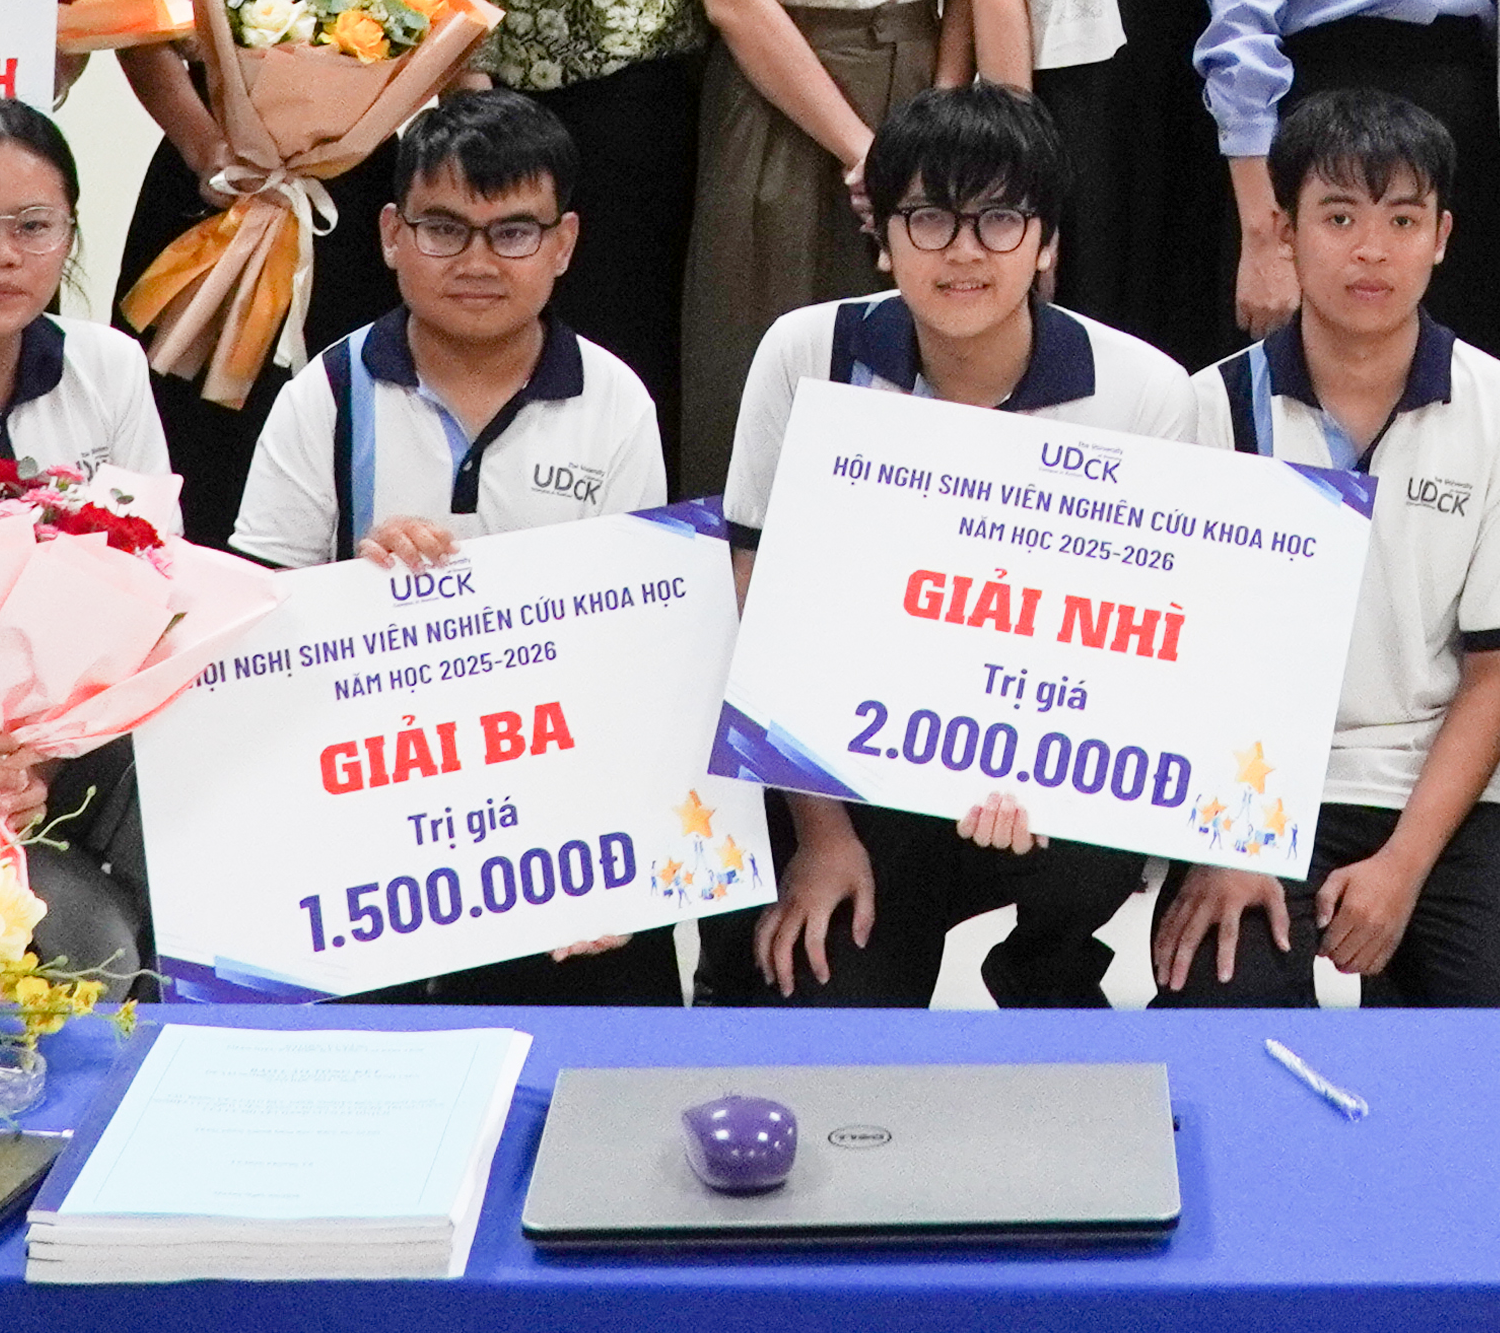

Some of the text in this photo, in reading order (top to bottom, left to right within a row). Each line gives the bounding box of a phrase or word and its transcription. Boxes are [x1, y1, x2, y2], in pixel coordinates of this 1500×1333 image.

[534, 463, 601, 505] UDCK
[1040, 443, 1121, 484] UDCK
[833, 455, 1316, 558] HỘI NGHỊ SINH VIÊN NGHIÊN CỨU KHOA HỌC
[1408, 477, 1469, 517] UDCK
[959, 517, 1174, 571] NĂM HỌC 2025-2026
[390, 570, 476, 601] UDCK
[191, 577, 686, 691] ỘI NGHỊ SINH VIÊN NGHIÊN CỨU KHOA HỌC
[903, 568, 1185, 662] GIẢI NHÌ
[334, 641, 557, 701] NĂM HỌC 2025-2026
[984, 663, 1087, 713] Trị giá
[320, 702, 575, 795] GIẢI BA
[847, 700, 1192, 808] 2.000.000Đ
[407, 796, 518, 849] Trị giá
[299, 832, 637, 952] 1.500.000Đ
